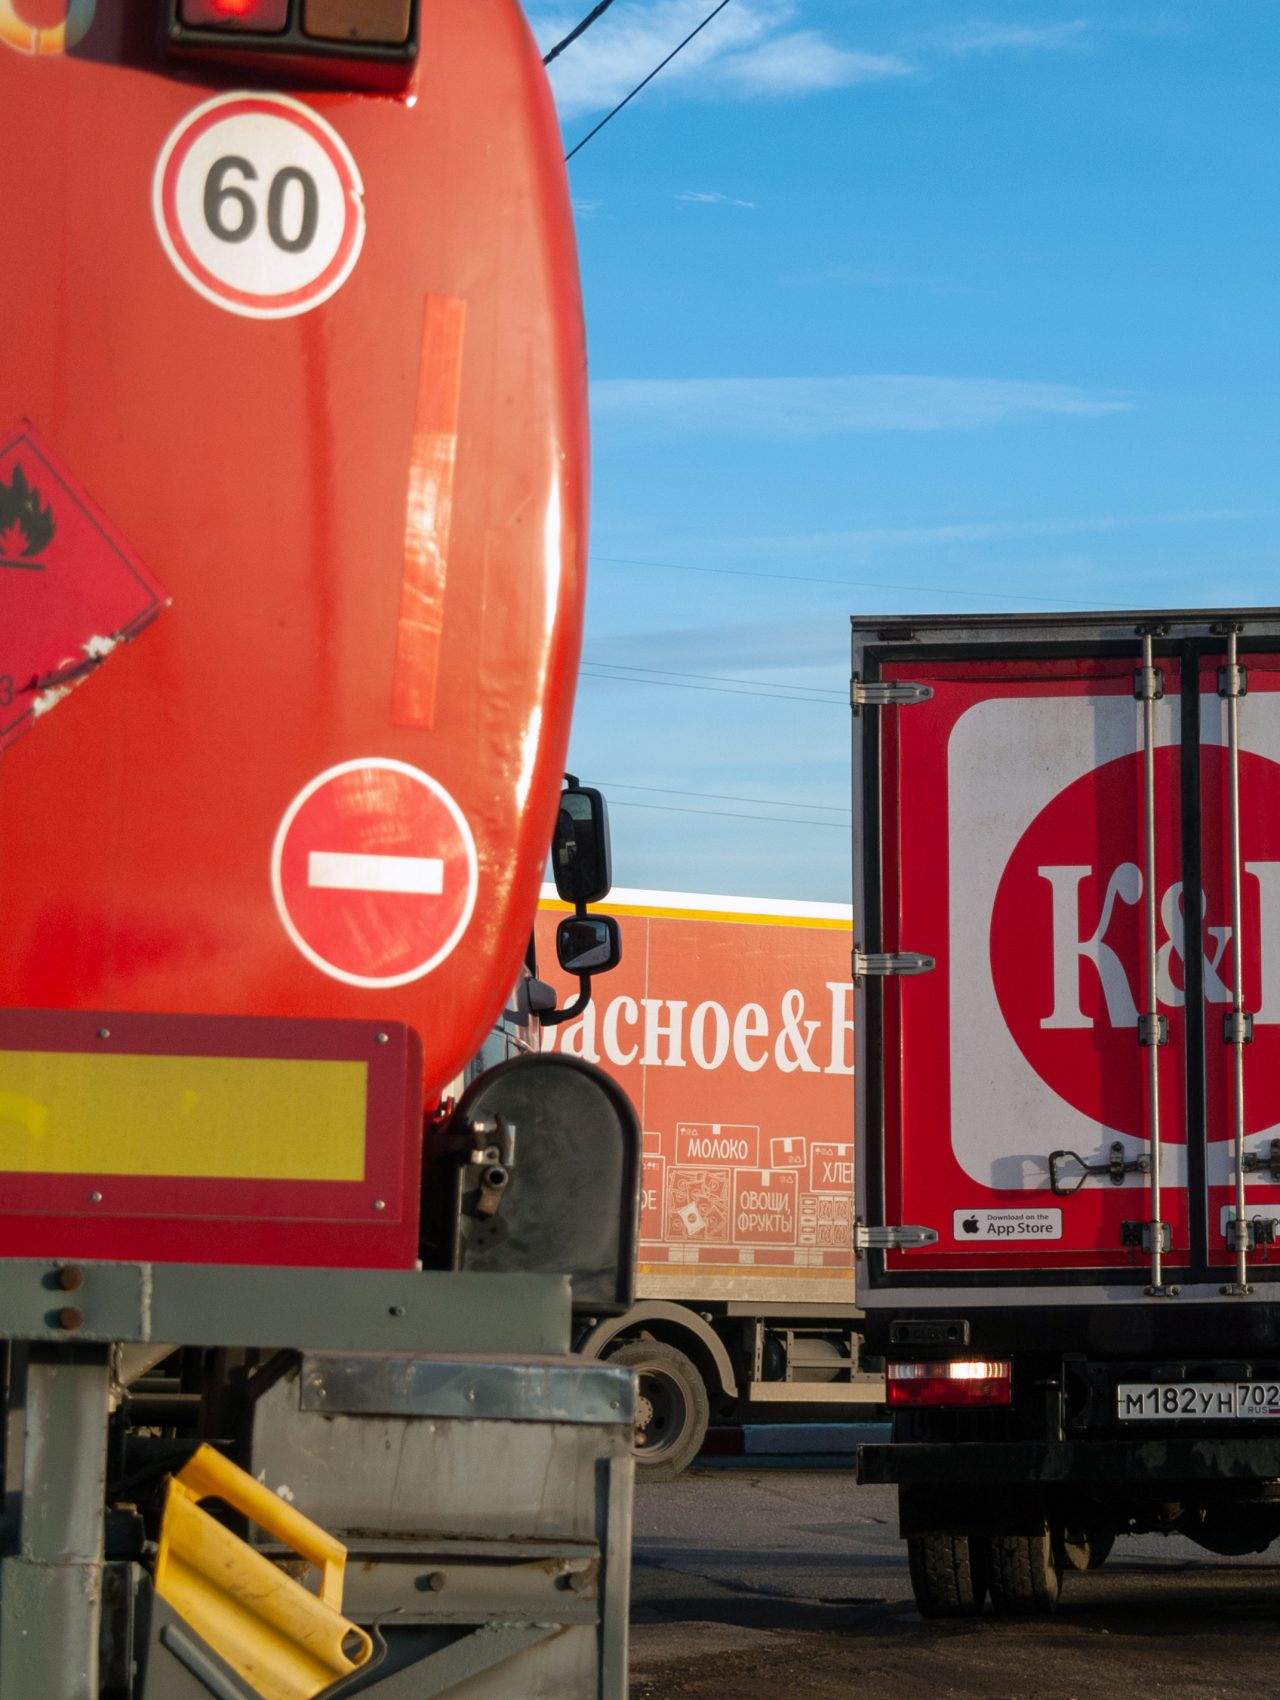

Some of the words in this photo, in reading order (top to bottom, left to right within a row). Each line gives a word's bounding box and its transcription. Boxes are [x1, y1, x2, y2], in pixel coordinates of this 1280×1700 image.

[203, 154, 319, 254] 60
[687, 1138, 749, 1160] МОЛОКО
[822, 1161, 854, 1184] ХЛЕ
[740, 1191, 792, 1215] ОВОЩИ,
[737, 1212, 792, 1234] ФРУКТЫ
[986, 1223, 1015, 1236] App
[1017, 1222, 1054, 1234] Store
[1247, 1406, 1268, 1414] RUS
